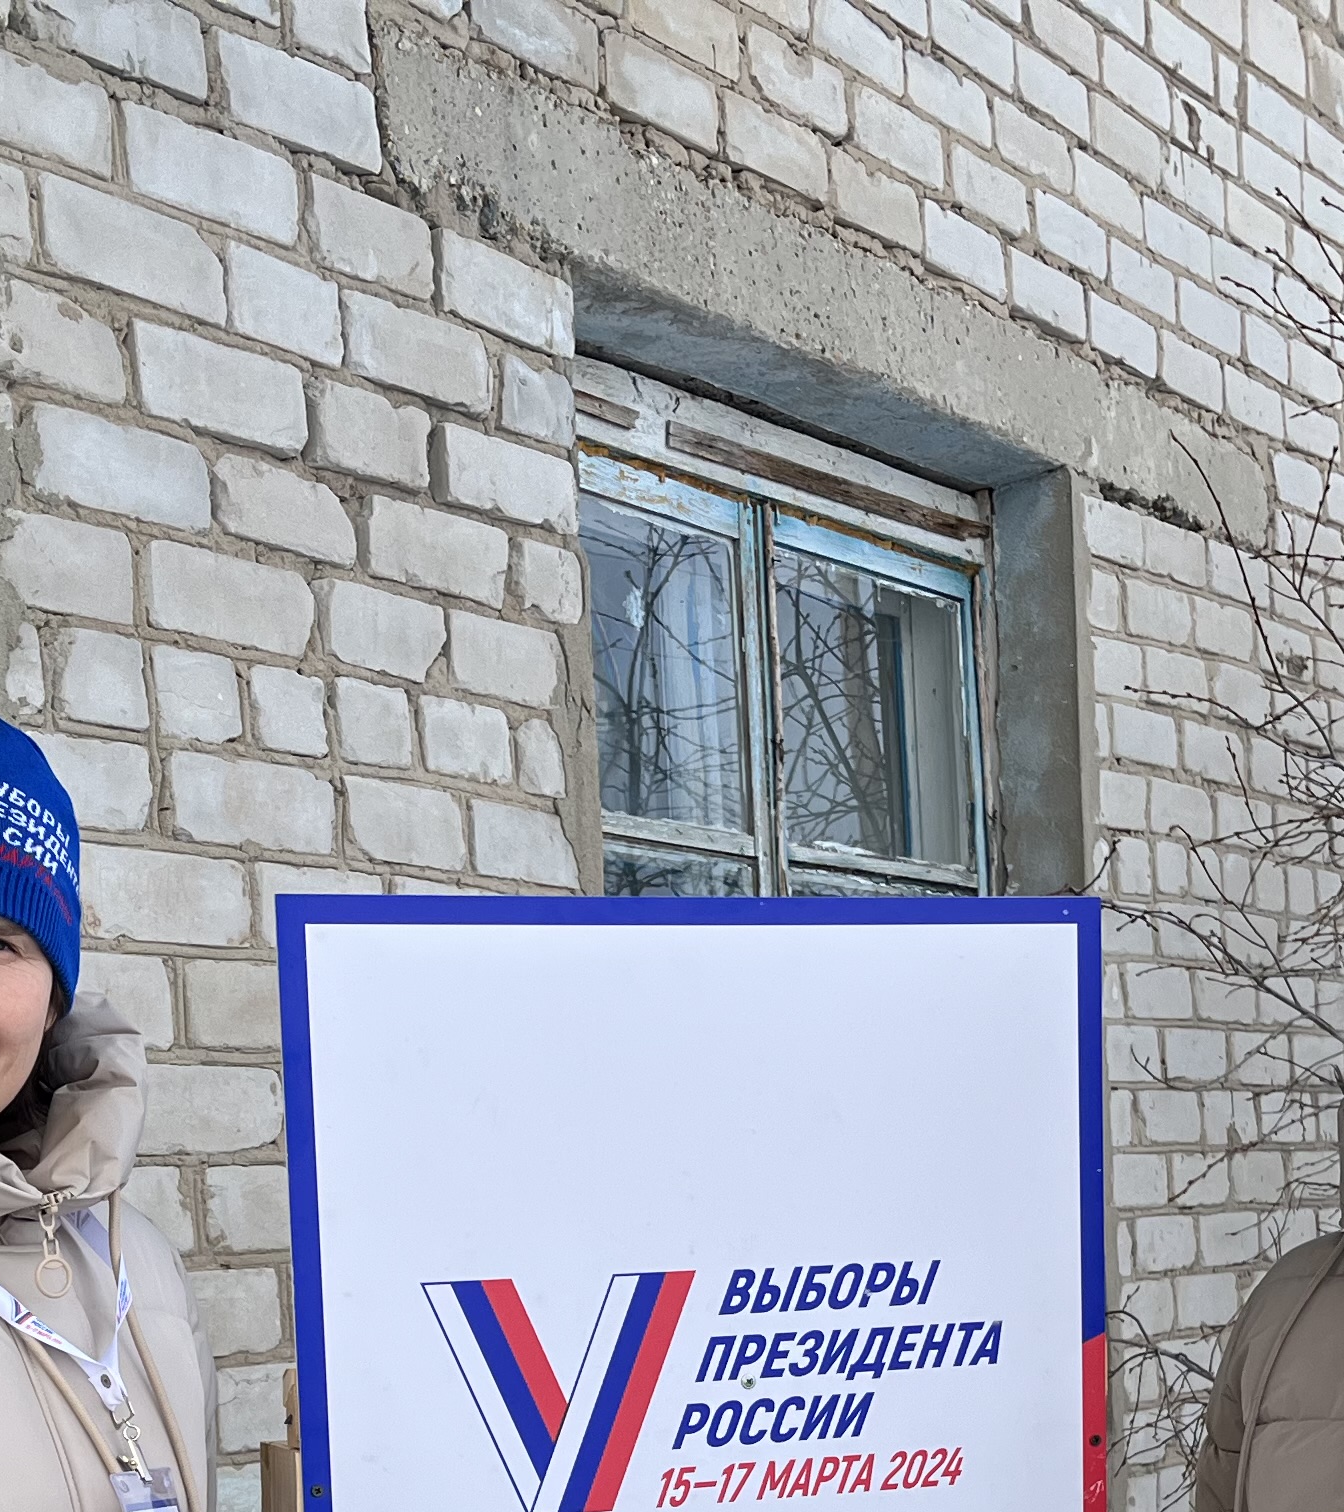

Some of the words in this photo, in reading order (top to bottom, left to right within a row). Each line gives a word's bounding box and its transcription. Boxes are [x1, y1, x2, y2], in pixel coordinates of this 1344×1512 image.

[717, 1259, 941, 1316] ВЫБОРЫ
[695, 1320, 1004, 1383] ПРЕЗИДЕНТА
[671, 1391, 875, 1451] РОССИИ
[756, 1453, 878, 1503] МАРТА
[879, 1446, 964, 1491] 2024
